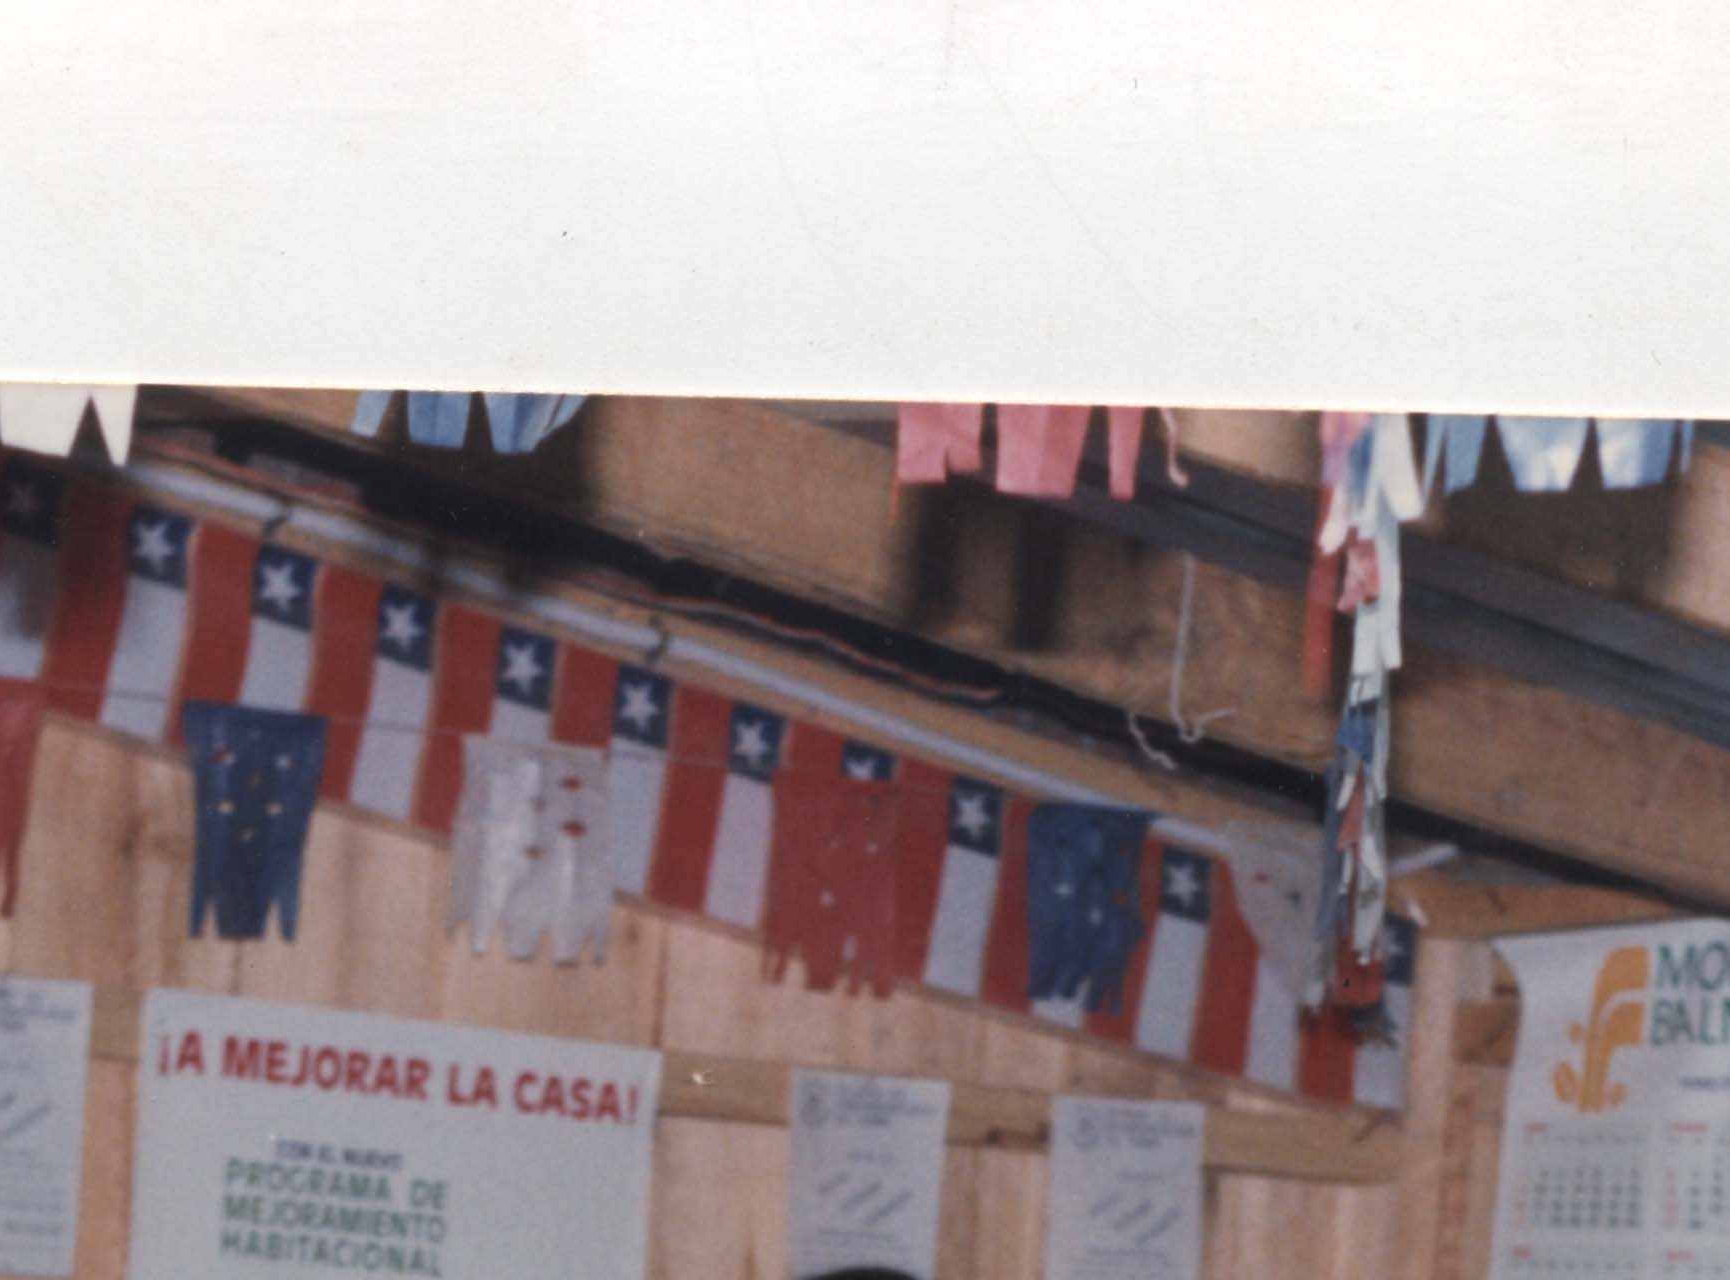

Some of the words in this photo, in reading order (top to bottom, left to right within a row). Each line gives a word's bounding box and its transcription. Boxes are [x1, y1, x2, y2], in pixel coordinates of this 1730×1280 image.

[158, 1032, 205, 1078] ¡A
[221, 1034, 432, 1101] MEJORAR
[446, 1063, 498, 1110] LA
[512, 1071, 640, 1127] CASA!
[224, 1156, 393, 1201] PROGRAMA
[408, 1178, 450, 1212] DE
[221, 1195, 449, 1244] MEJORAMIENTO
[219, 1229, 445, 1279] HABITACIONAL
